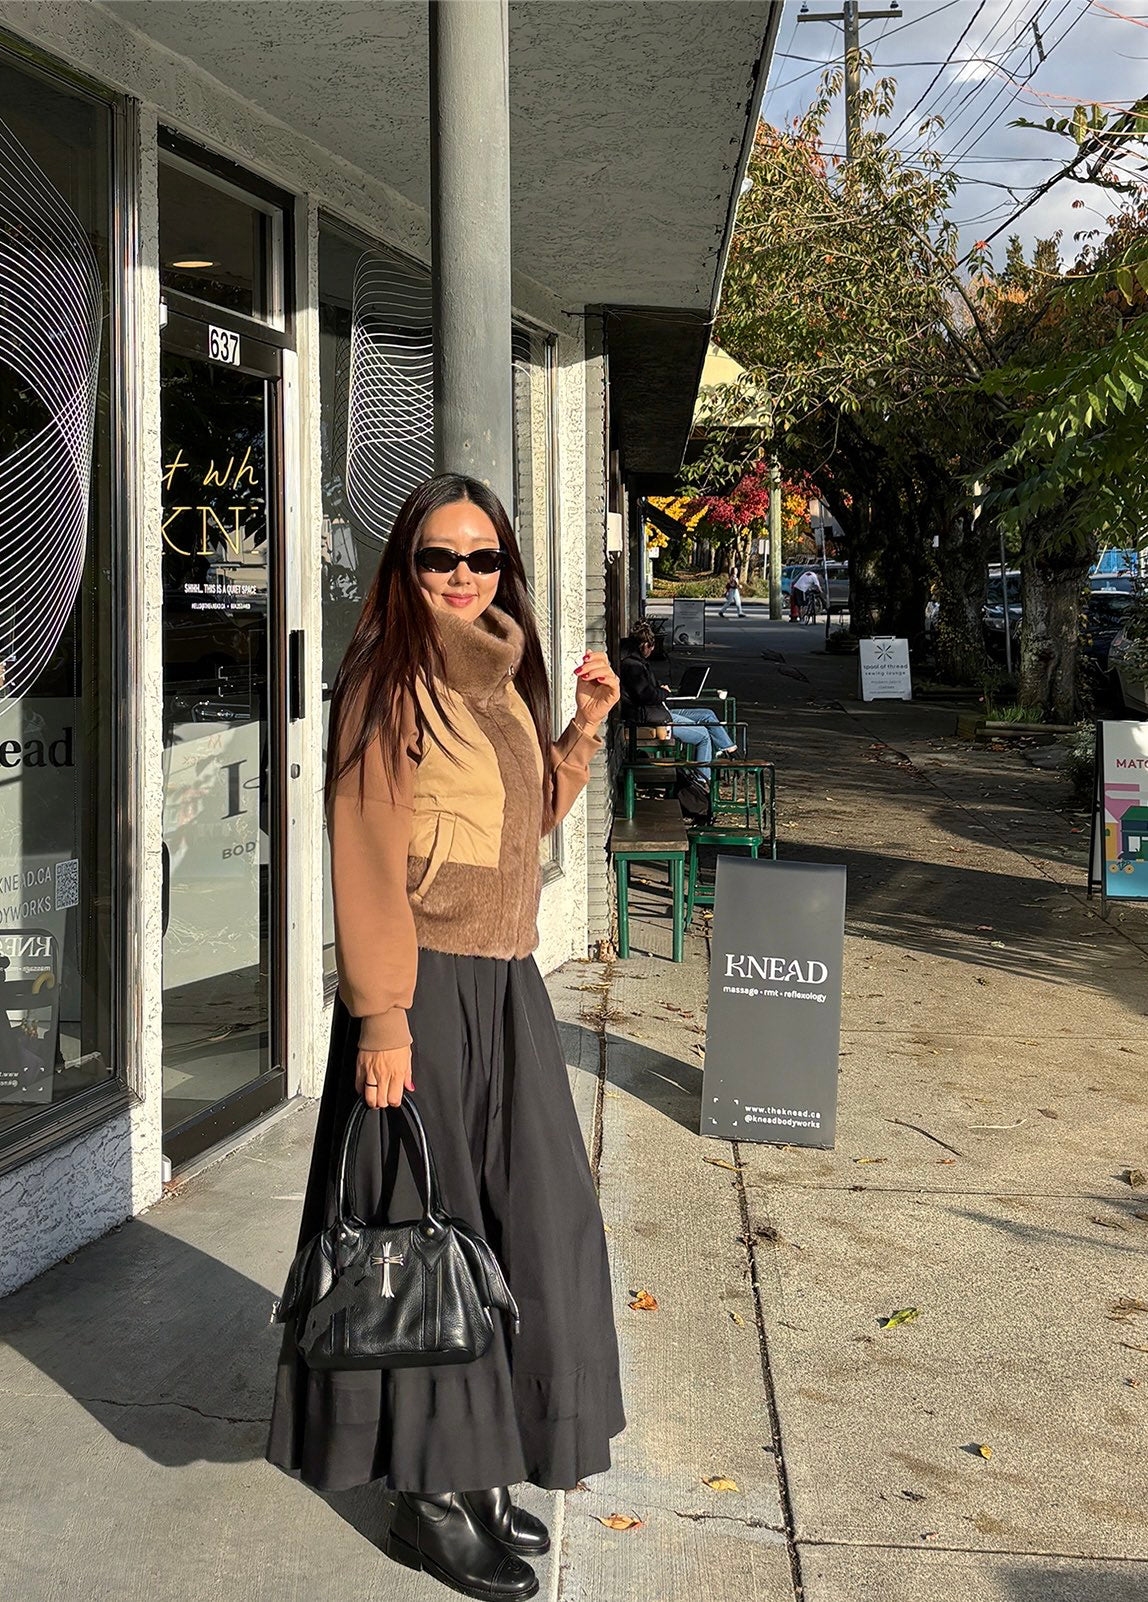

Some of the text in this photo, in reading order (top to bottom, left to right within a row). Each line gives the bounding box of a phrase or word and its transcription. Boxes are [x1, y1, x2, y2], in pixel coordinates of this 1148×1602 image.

[210, 328, 239, 363] 637
[204, 584, 216, 593] THIS
[216, 584, 222, 594] IS
[222, 585, 226, 594] A
[227, 585, 241, 596] QUIET
[241, 585, 257, 595] SPACE
[0, 727, 75, 767] ead
[724, 953, 828, 984] KNEAD
[723, 985, 827, 1003] massage rmt reflexology
[744, 1105, 821, 1119] www.theknead.ca
[744, 1114, 821, 1129] @kneadbodyworks
